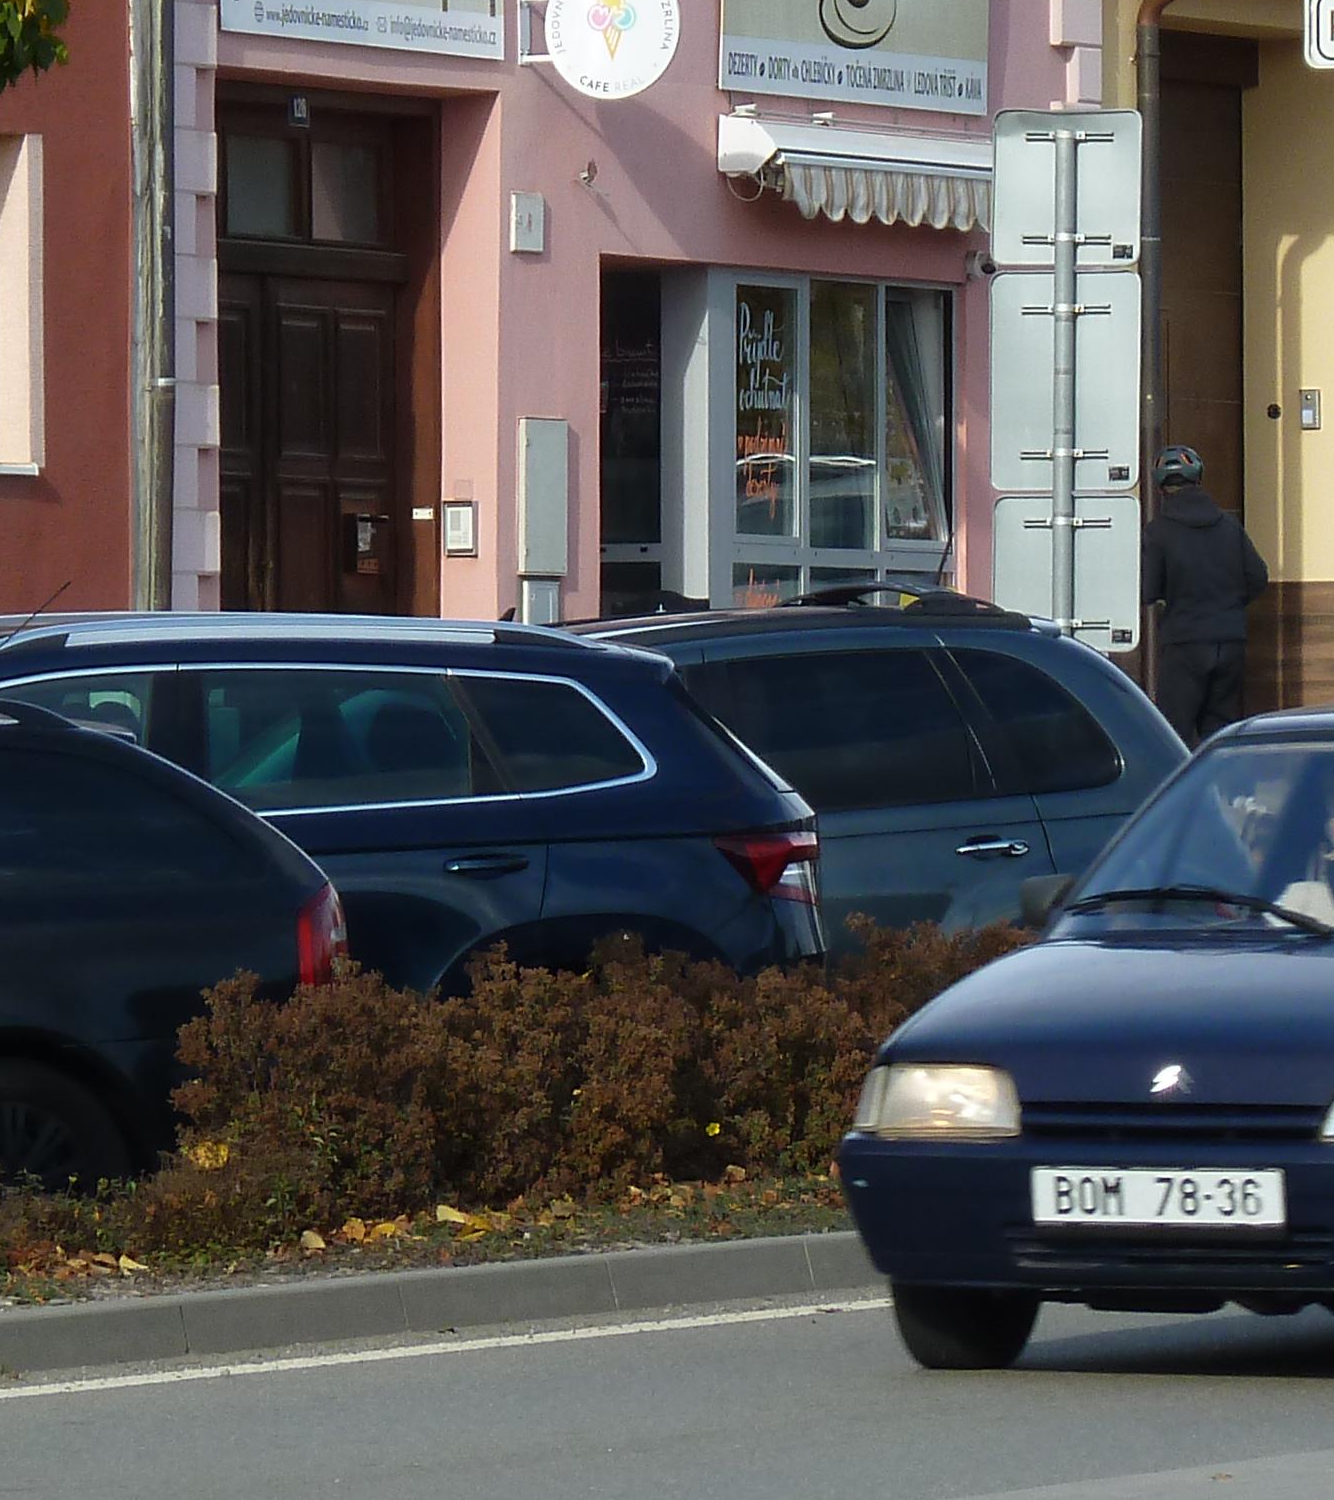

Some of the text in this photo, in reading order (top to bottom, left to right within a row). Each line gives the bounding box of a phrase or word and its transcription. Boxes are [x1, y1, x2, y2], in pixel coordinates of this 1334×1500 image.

[579, 75, 609, 92] CAFE
[1053, 1176, 1262, 1217] BOM 78-36
